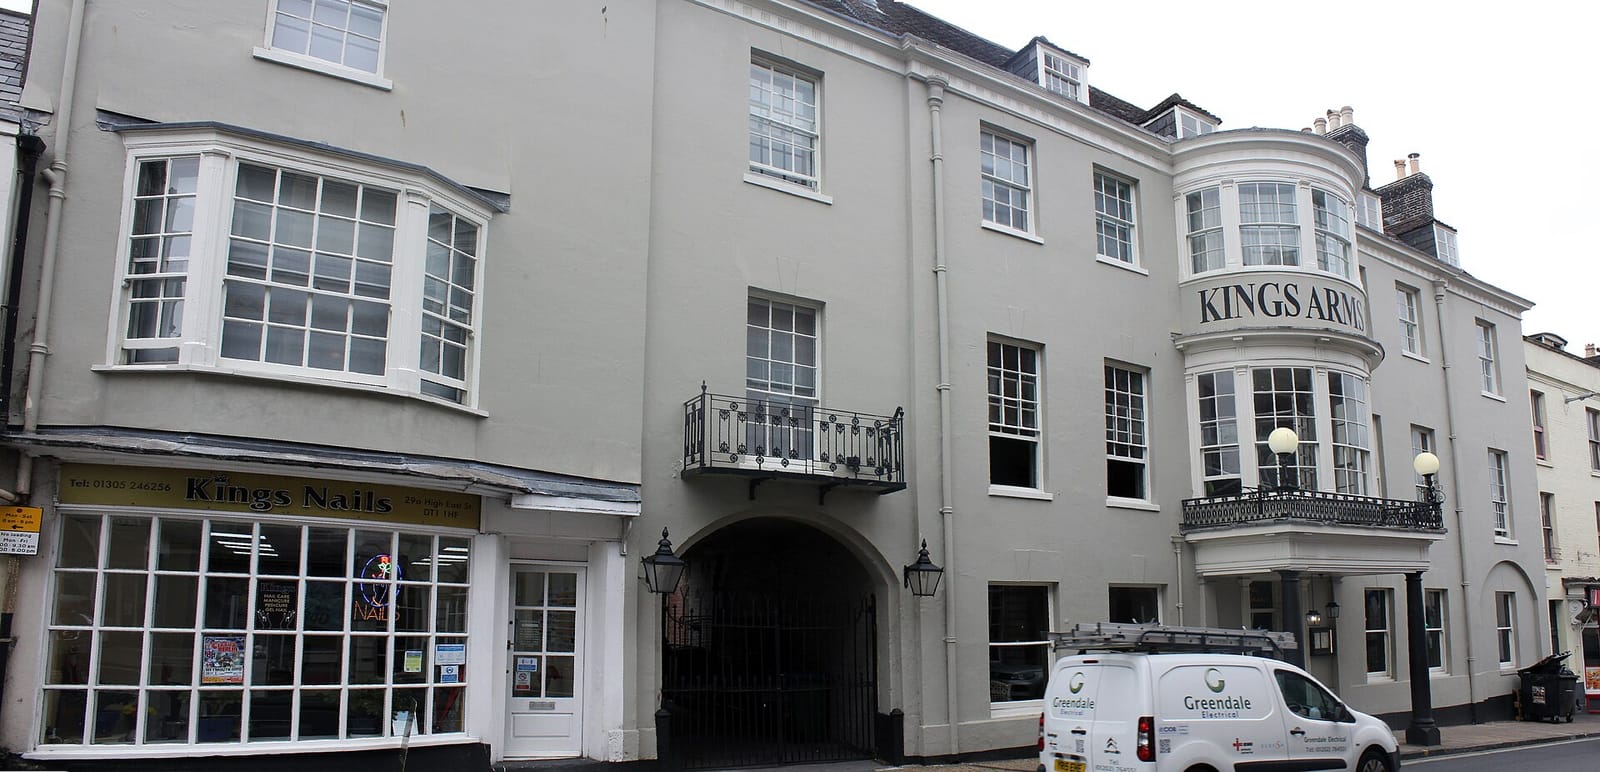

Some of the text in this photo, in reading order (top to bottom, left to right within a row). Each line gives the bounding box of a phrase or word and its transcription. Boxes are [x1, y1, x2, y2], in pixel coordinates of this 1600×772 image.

[1198, 282, 1364, 332] KINGS ARMS
[69, 479, 171, 491] Tel: 01305 246256
[186, 475, 393, 512] Kings Nails
[424, 496, 443, 508] High
[1053, 696, 1095, 710] Greendale
[1184, 696, 1252, 710] Greendale
[1202, 711, 1240, 719] Electrical
